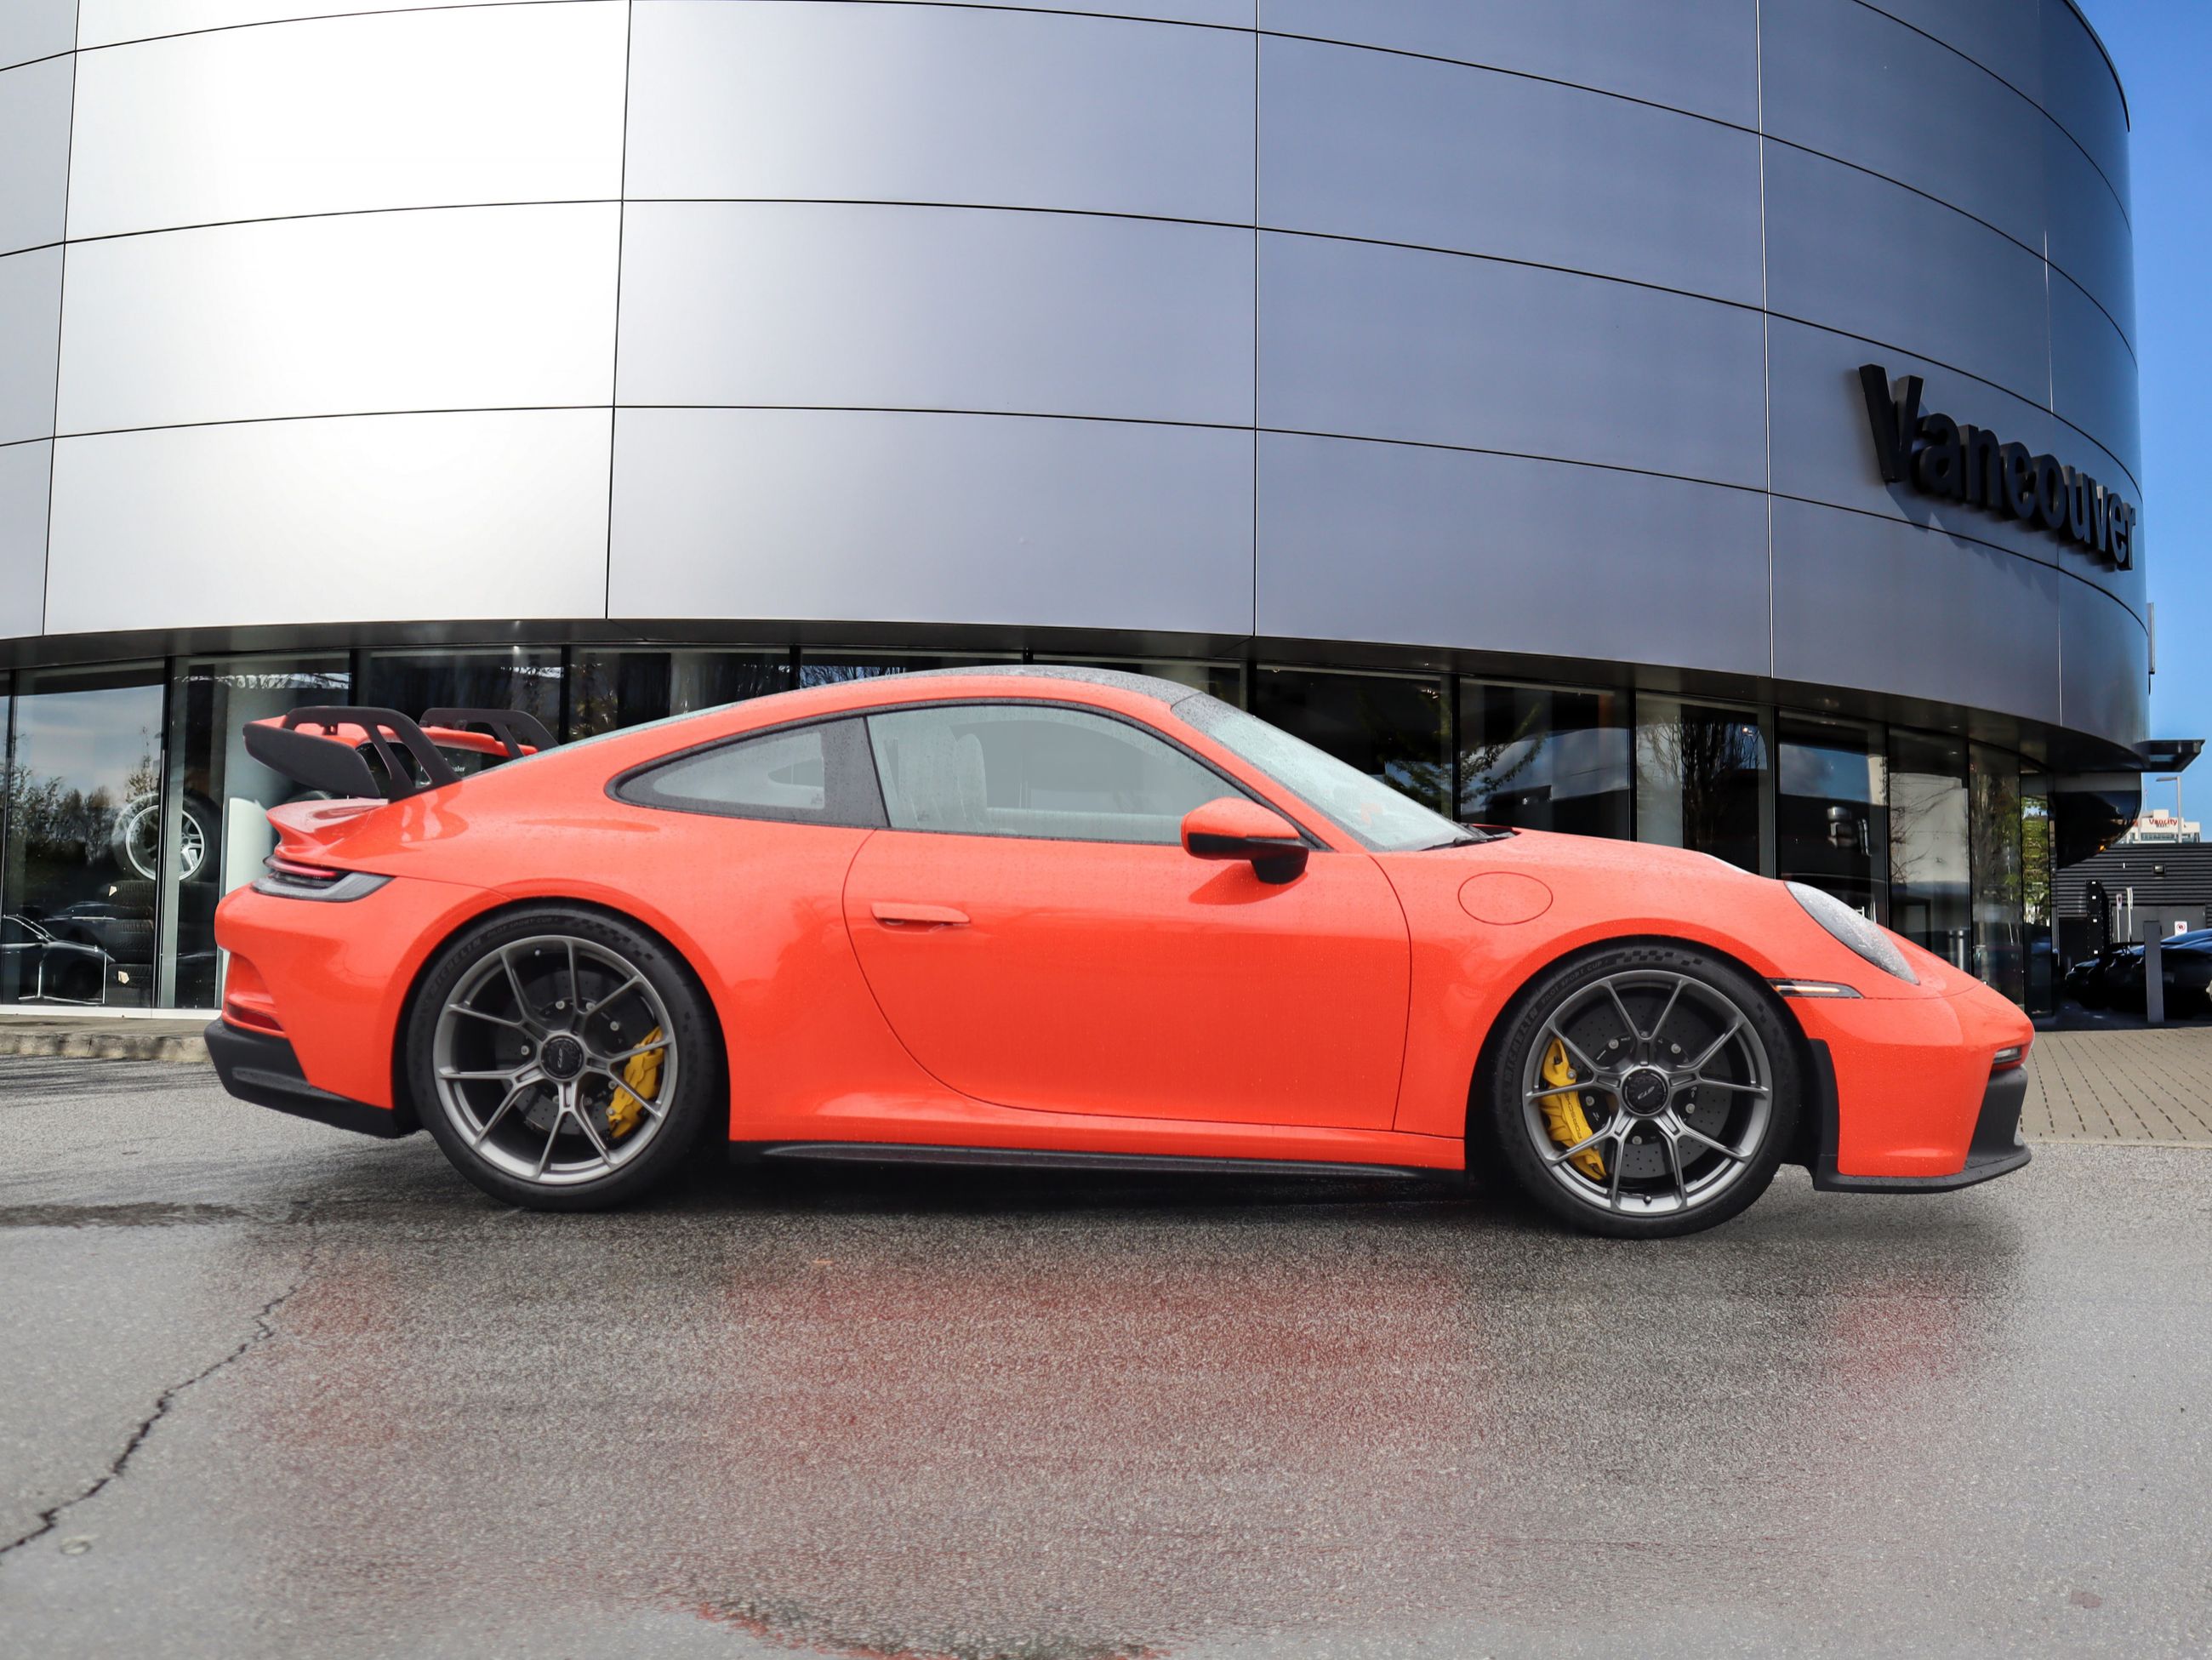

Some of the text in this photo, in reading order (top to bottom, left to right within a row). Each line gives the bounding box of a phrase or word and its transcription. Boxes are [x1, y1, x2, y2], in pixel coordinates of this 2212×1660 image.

[1859, 363, 2136, 571] Vancouver
[430, 938, 482, 995] MICHELIN
[1505, 1007, 1539, 1082] MICHELIN
[1560, 969, 1584, 987] SPORT
[1587, 961, 1603, 971] CUP
